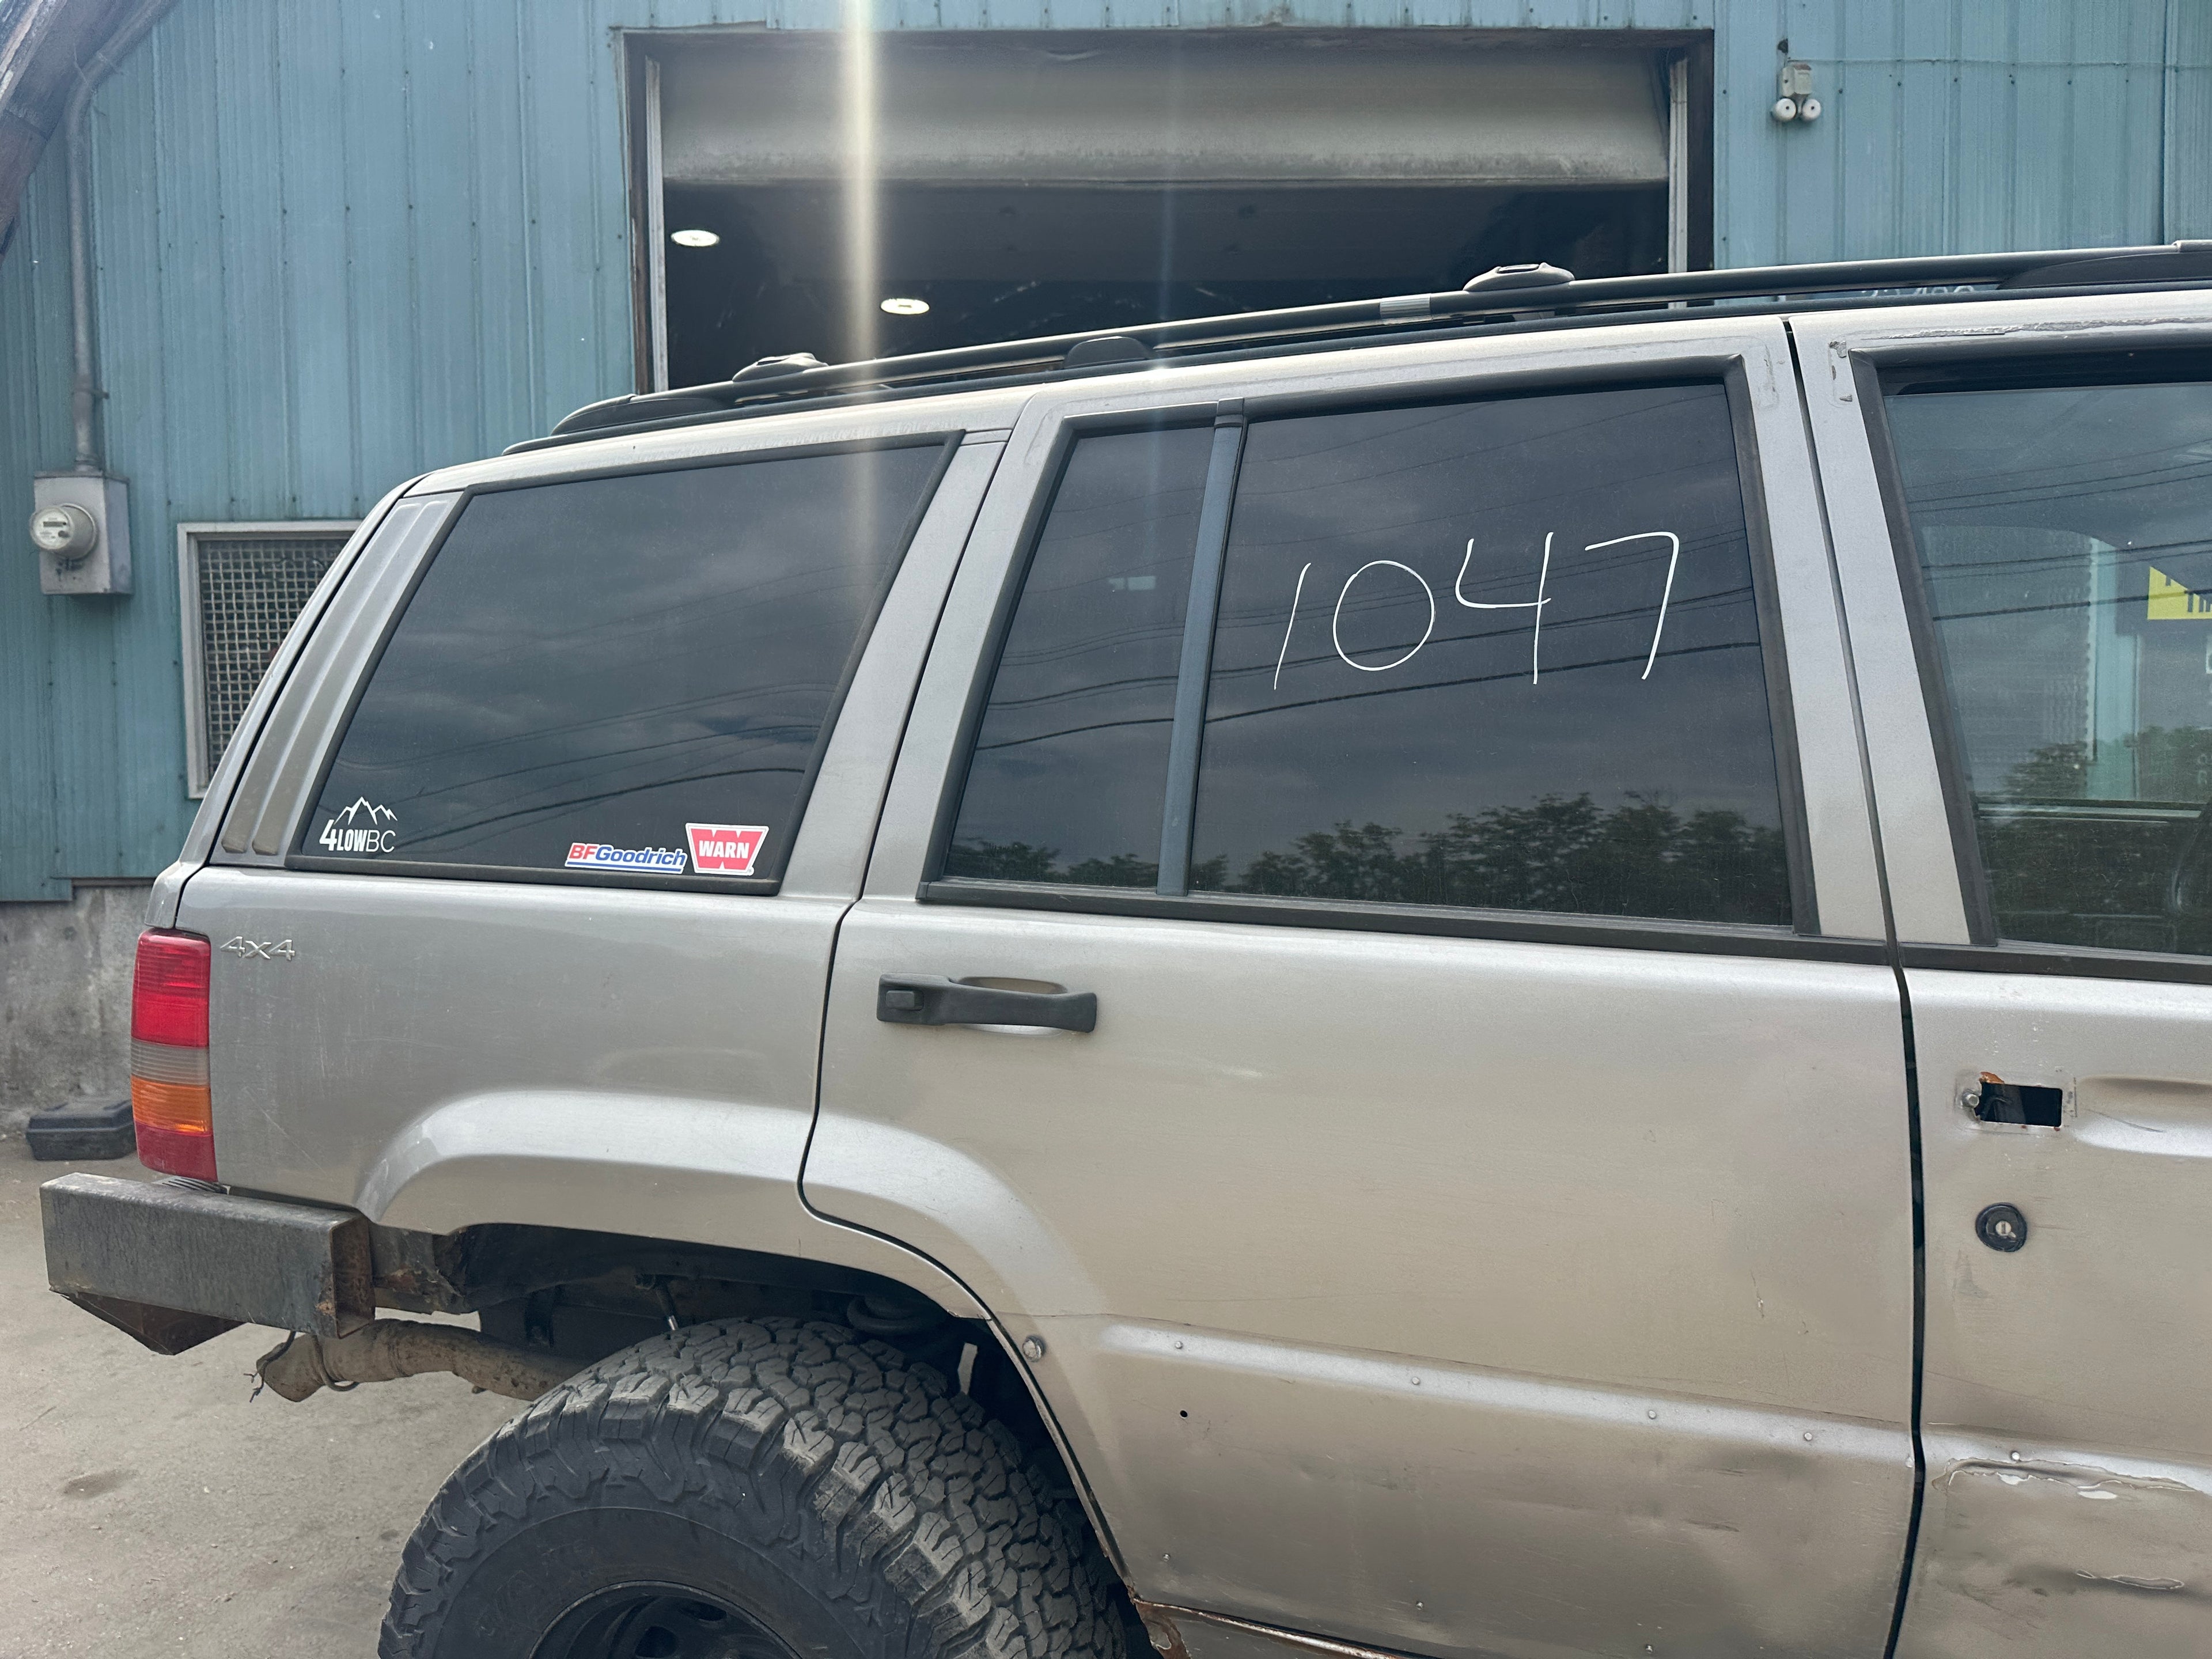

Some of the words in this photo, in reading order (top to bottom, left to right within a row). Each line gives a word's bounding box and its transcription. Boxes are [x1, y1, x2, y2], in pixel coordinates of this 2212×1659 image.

[1274, 531, 1680, 690] 1047
[569, 844, 687, 866] BFGoodrich
[698, 840, 750, 859] WARN
